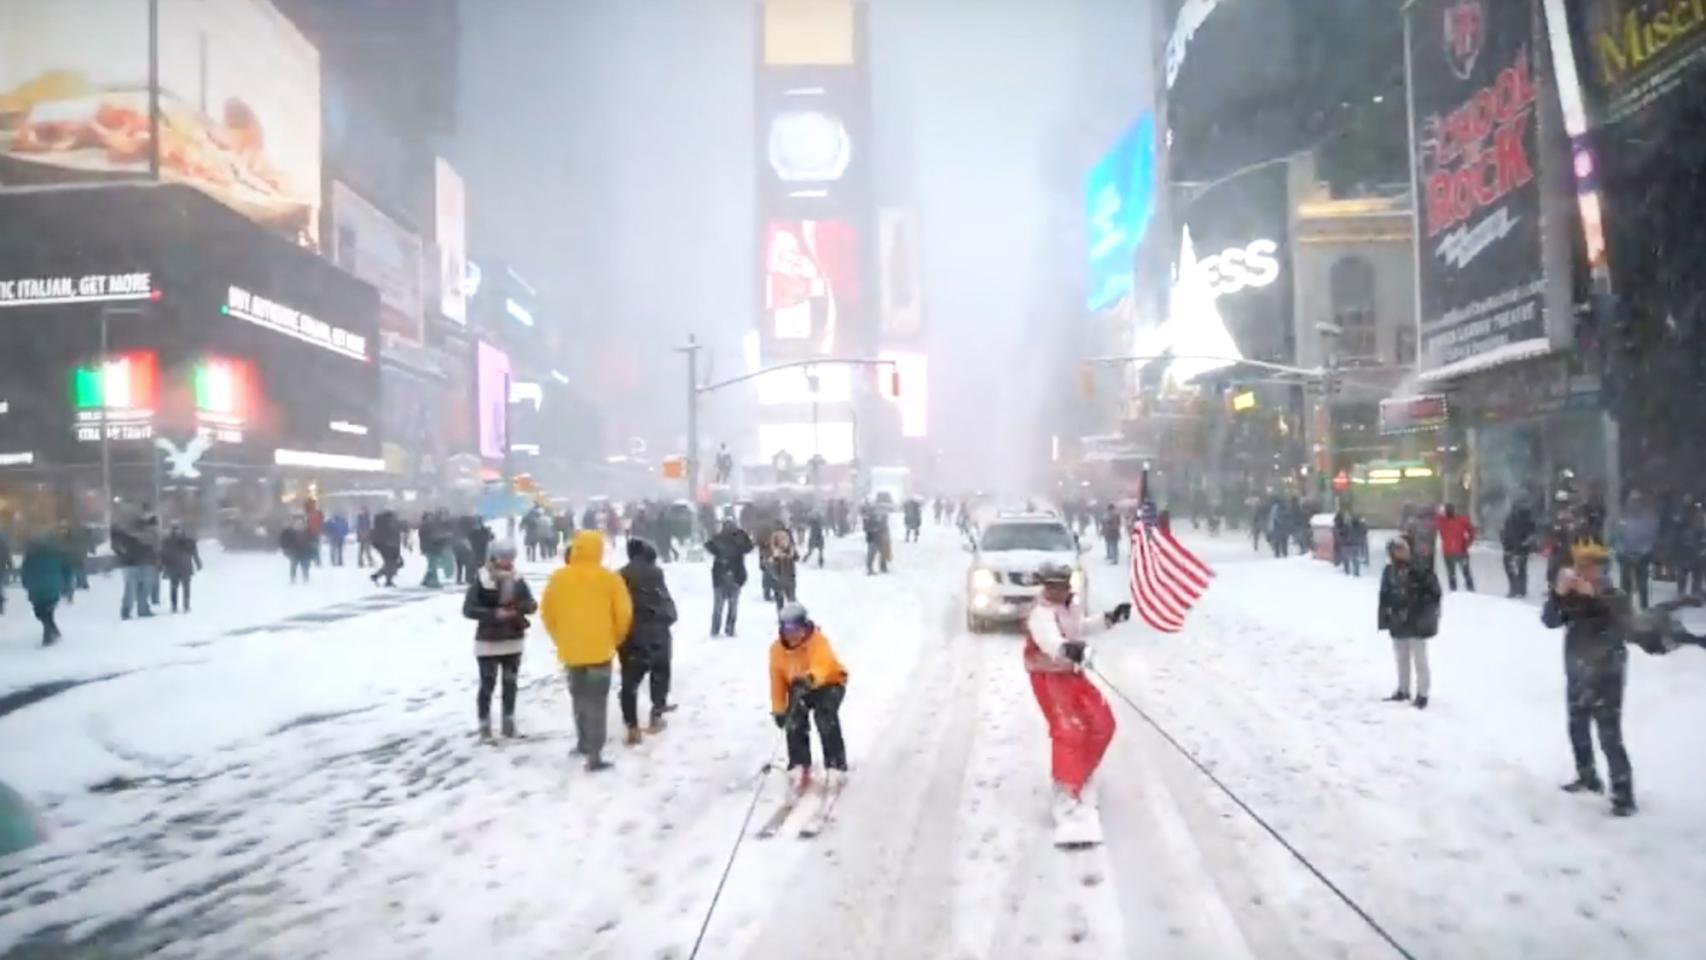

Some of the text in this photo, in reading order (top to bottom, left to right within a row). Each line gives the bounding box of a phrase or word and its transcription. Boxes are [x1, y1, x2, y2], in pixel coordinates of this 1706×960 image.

[1427, 110, 1534, 237] ROCK
[17, 277, 76, 298] ITALIAN,
[79, 275, 105, 296] GET
[109, 272, 150, 293] MORE
